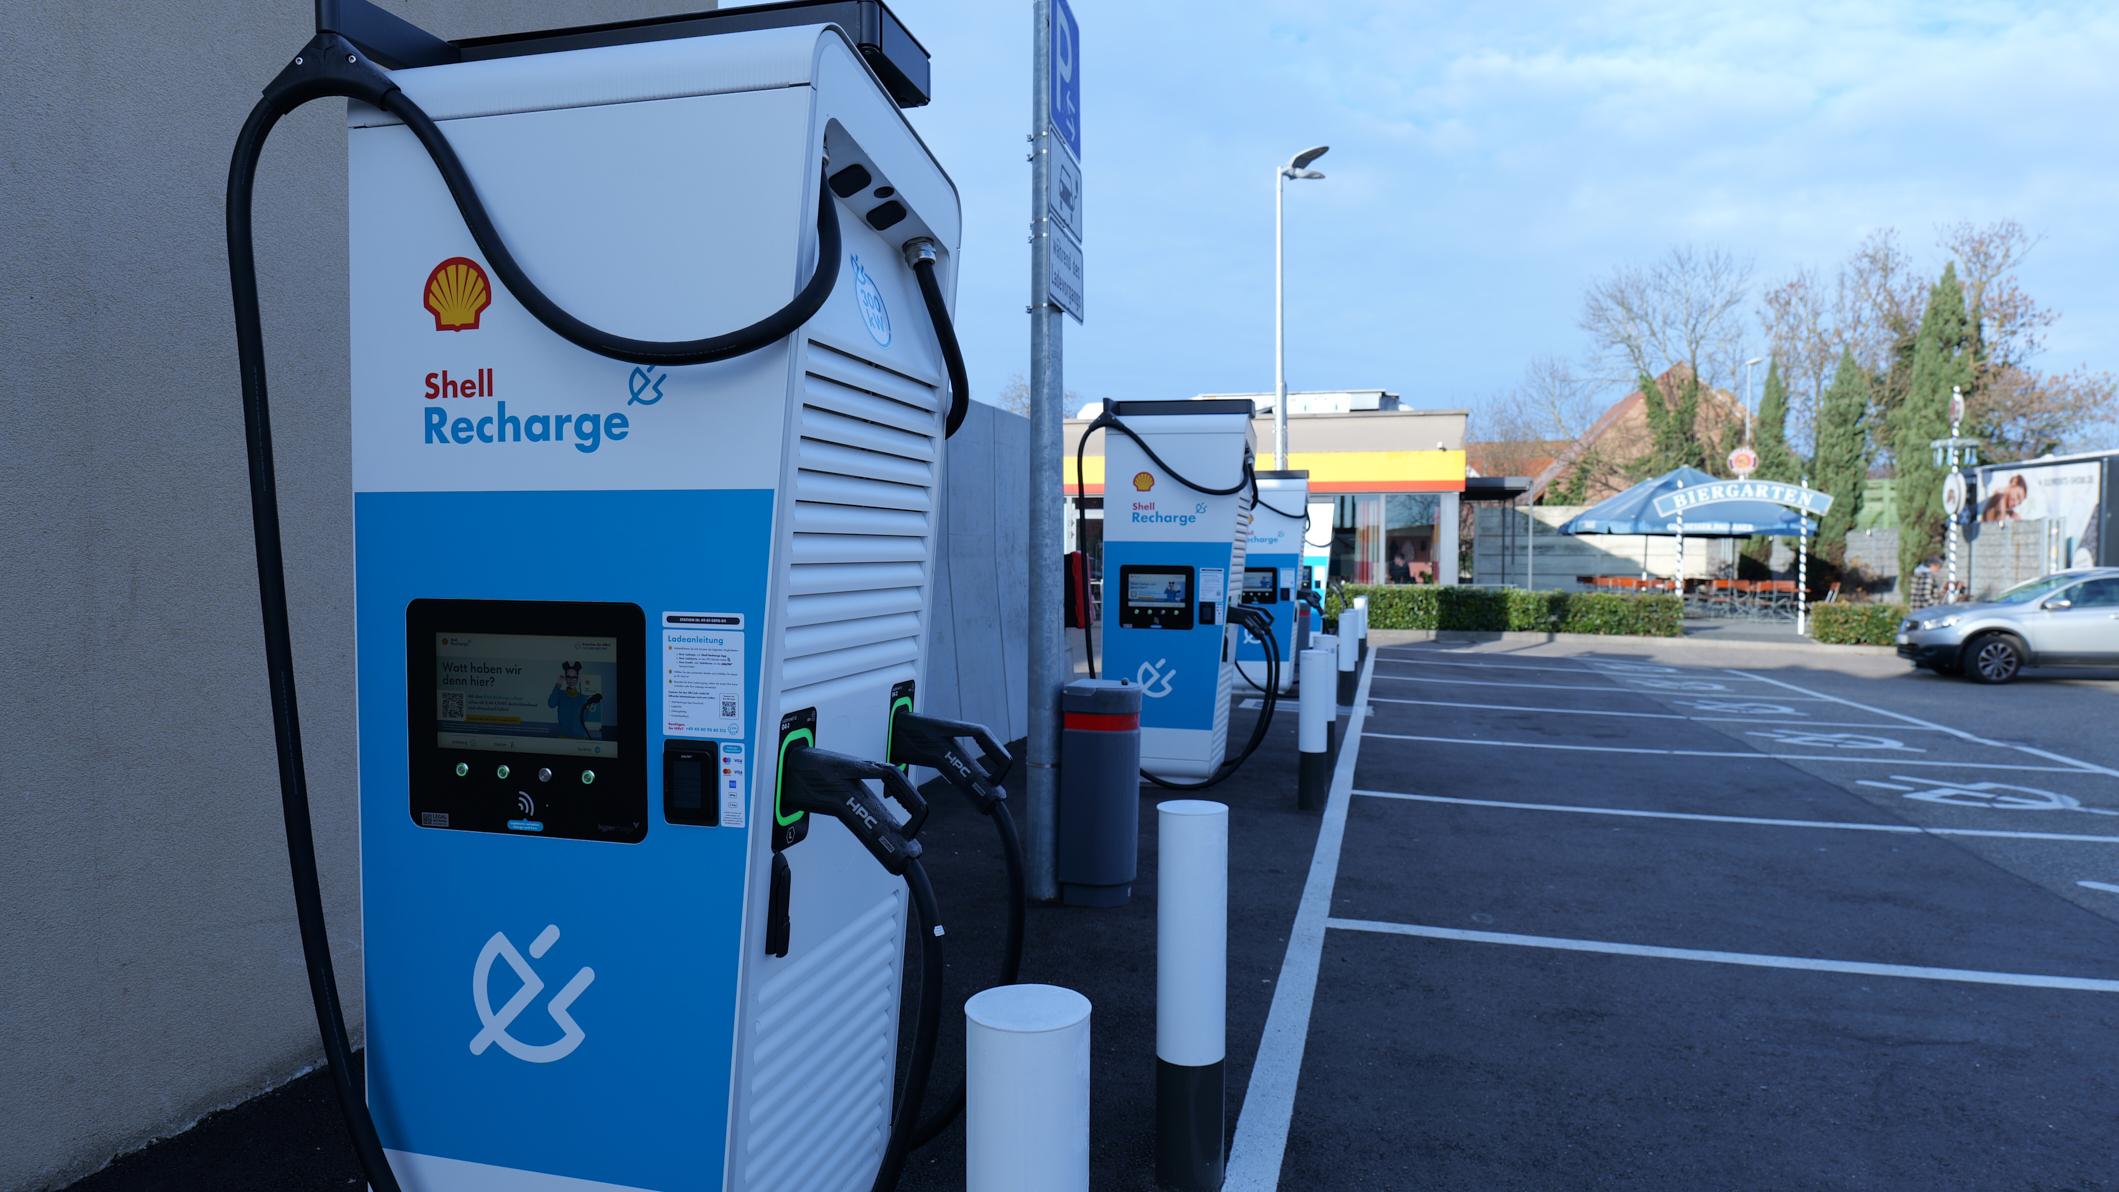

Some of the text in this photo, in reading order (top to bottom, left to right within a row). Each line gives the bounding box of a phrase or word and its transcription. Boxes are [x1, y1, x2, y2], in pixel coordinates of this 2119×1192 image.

[1056, 0, 1073, 113] P
[424, 368, 493, 399] Shell
[424, 401, 629, 453] Recharge
[1132, 502, 1155, 511] Shell
[1673, 483, 1813, 507] BIERGARTEN
[1132, 511, 1197, 526] Recharge
[668, 635, 724, 645] Ladeanleitung
[443, 662, 523, 675] Watt haben wir
[443, 675, 496, 687] denn hier?
[944, 751, 972, 778] HPC
[845, 797, 878, 830] HPC
